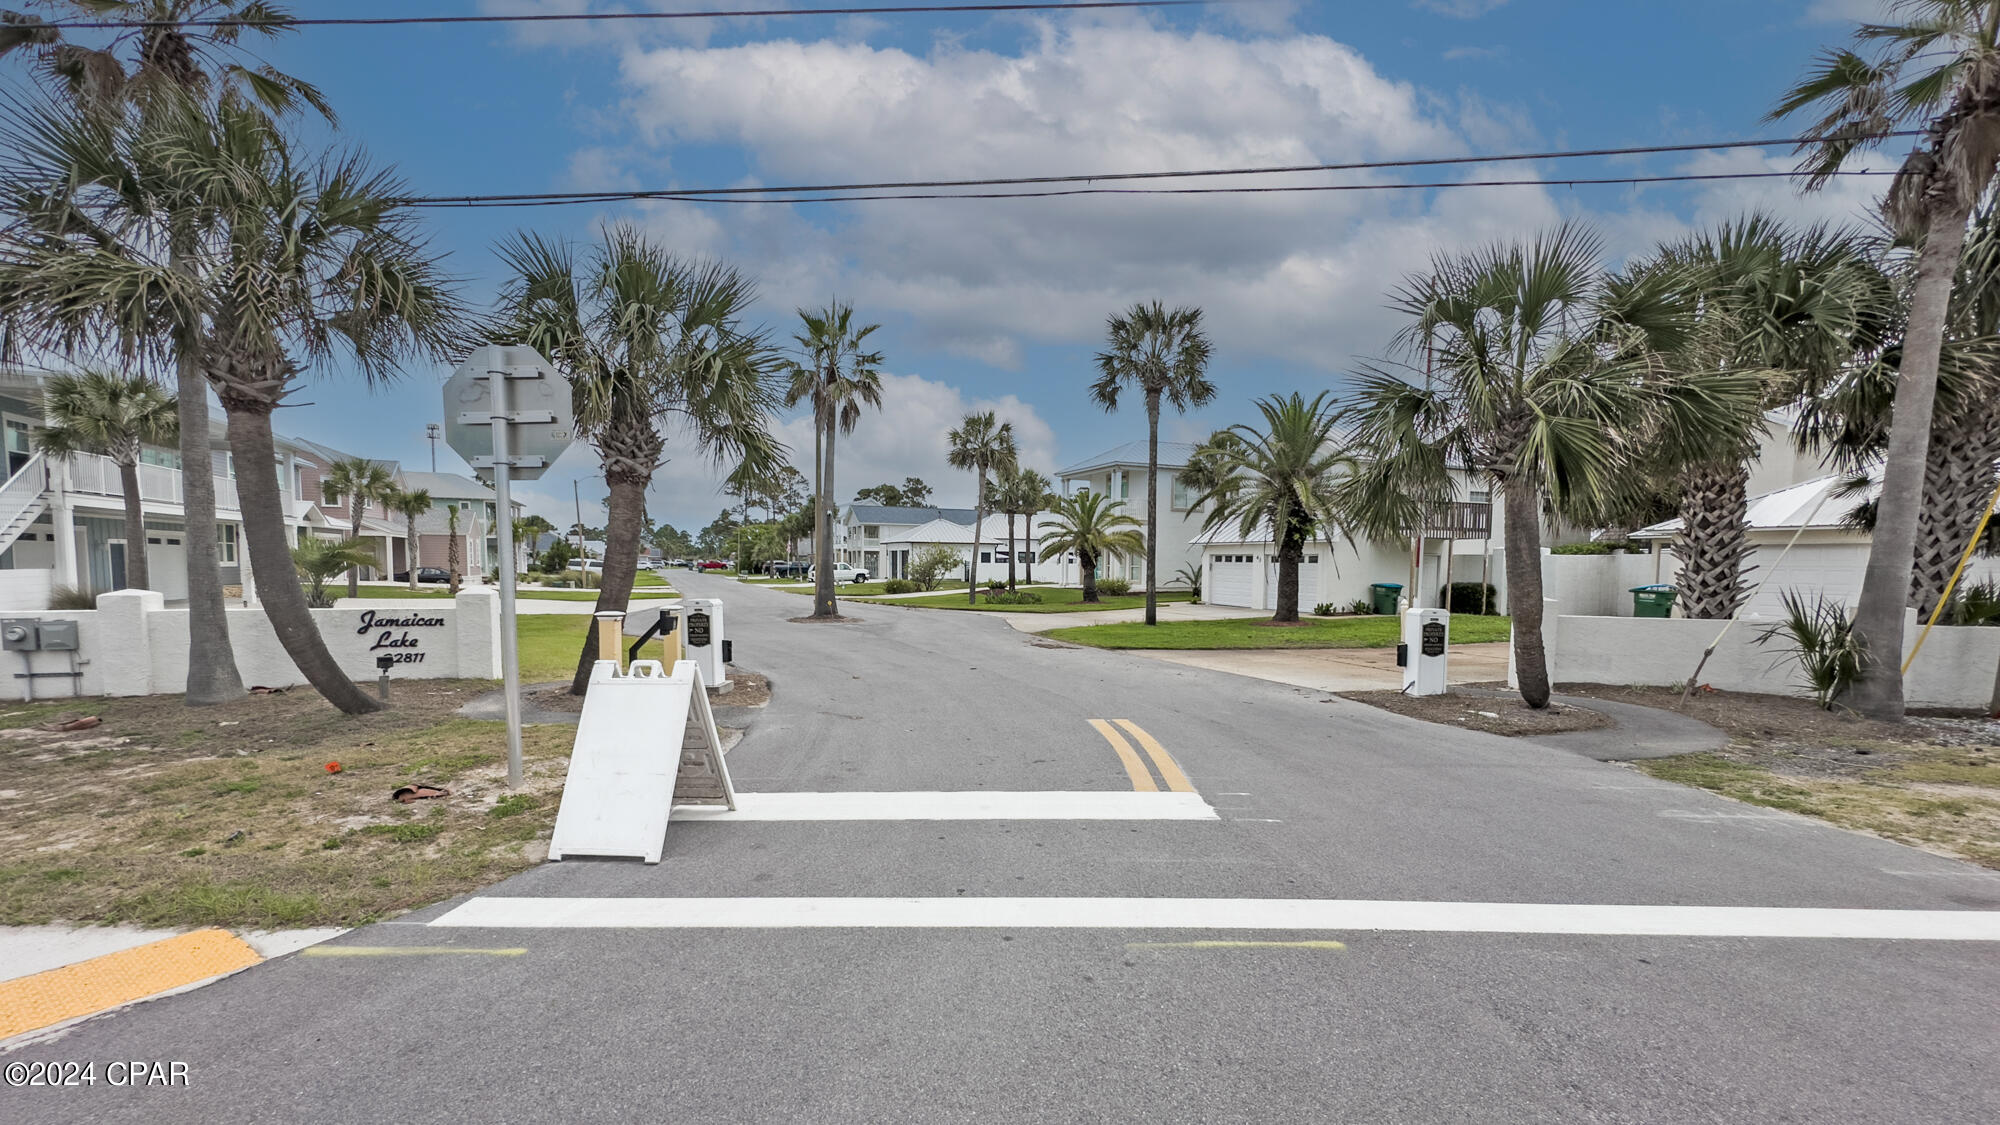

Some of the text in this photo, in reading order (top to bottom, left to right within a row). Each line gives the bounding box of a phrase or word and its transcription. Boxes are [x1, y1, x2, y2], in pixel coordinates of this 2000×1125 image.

[357, 610, 445, 634] Jamaican
[370, 631, 419, 651] Lake
[383, 653, 425, 663] 2811
